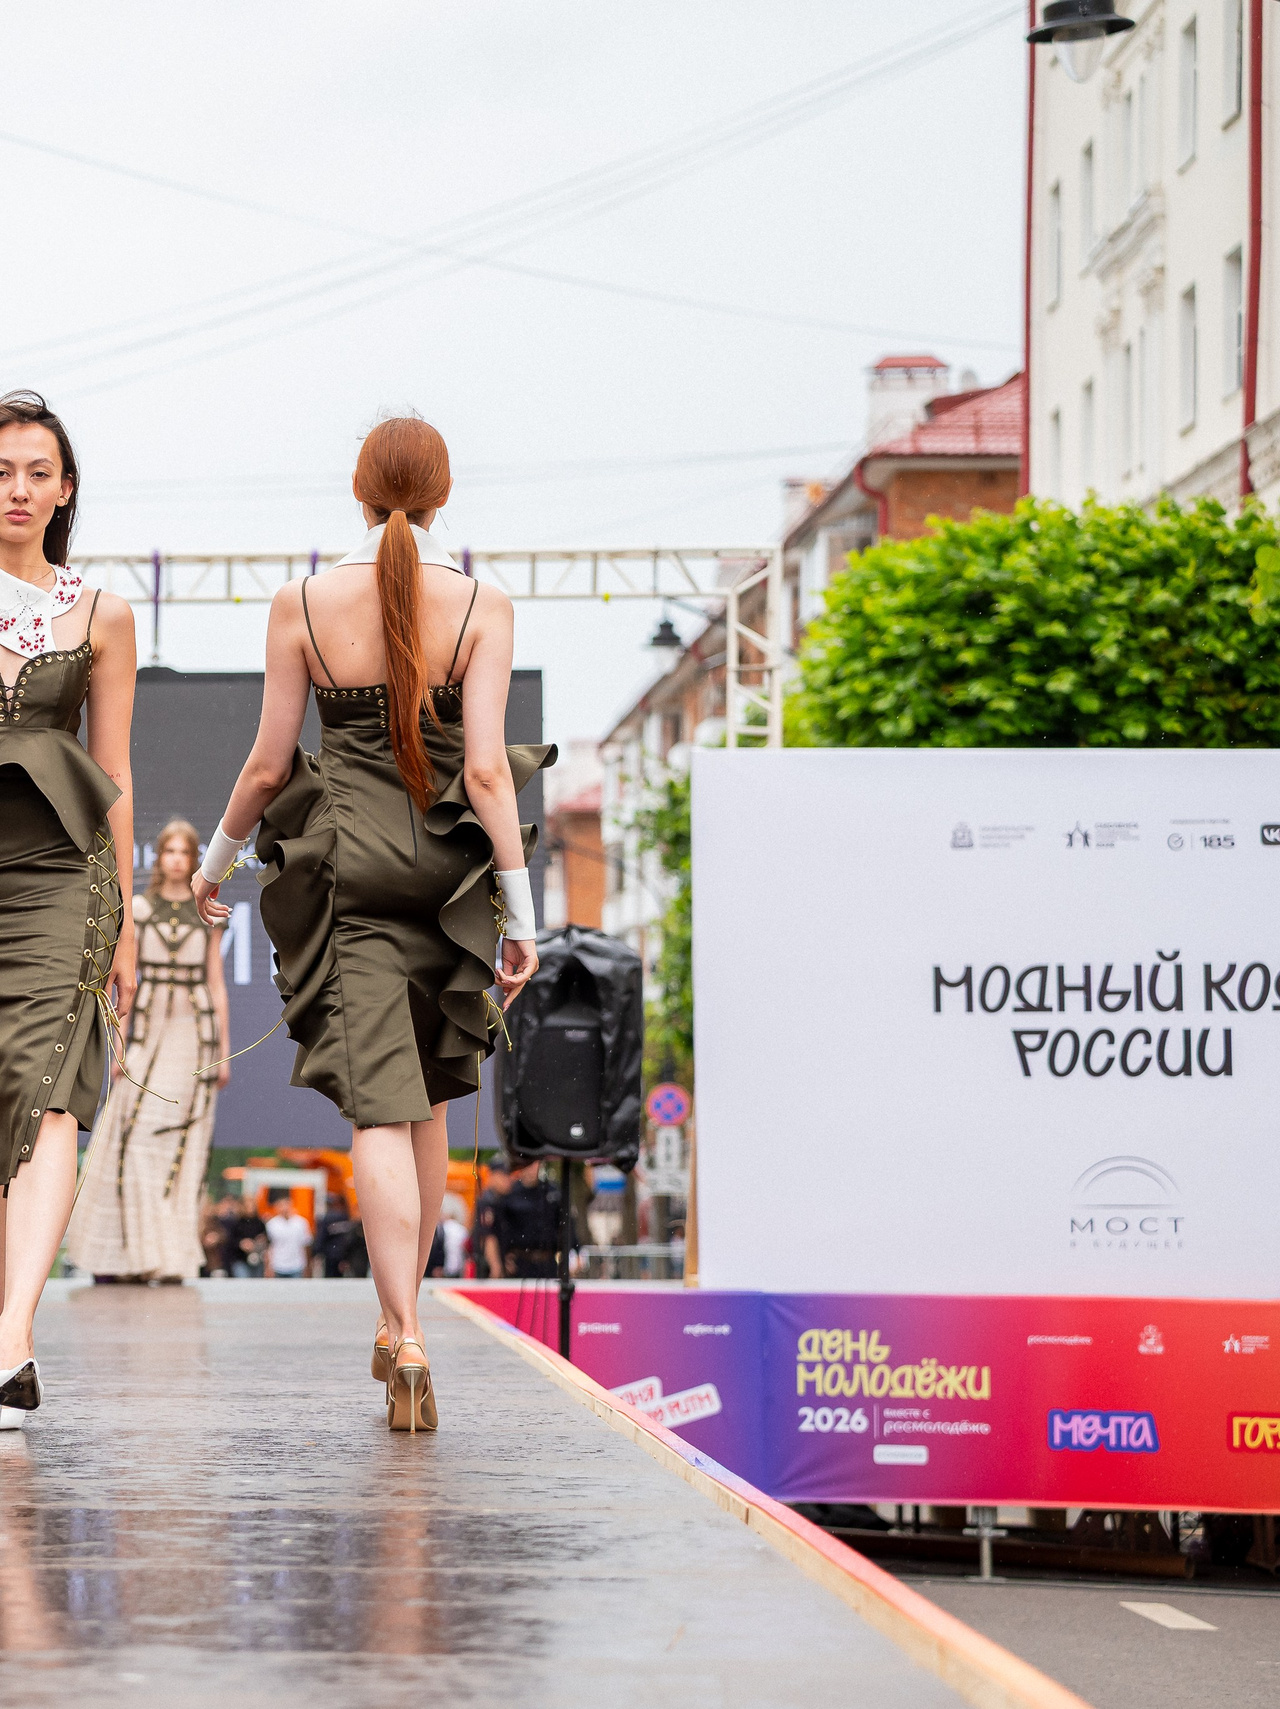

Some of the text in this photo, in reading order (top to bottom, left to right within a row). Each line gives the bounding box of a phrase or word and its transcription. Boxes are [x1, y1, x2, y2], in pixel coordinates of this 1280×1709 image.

[933, 949, 1185, 1013] МОДНЫЙ
[1012, 1027, 1234, 1078] РОССИИ
[1070, 1216, 1185, 1236] МОСТ
[796, 1328, 891, 1364] ДЕНЬ
[796, 1357, 992, 1400] МОЛОДЁЖИ
[798, 1406, 870, 1434] 2026
[1232, 1416, 1280, 1449] ГОР
